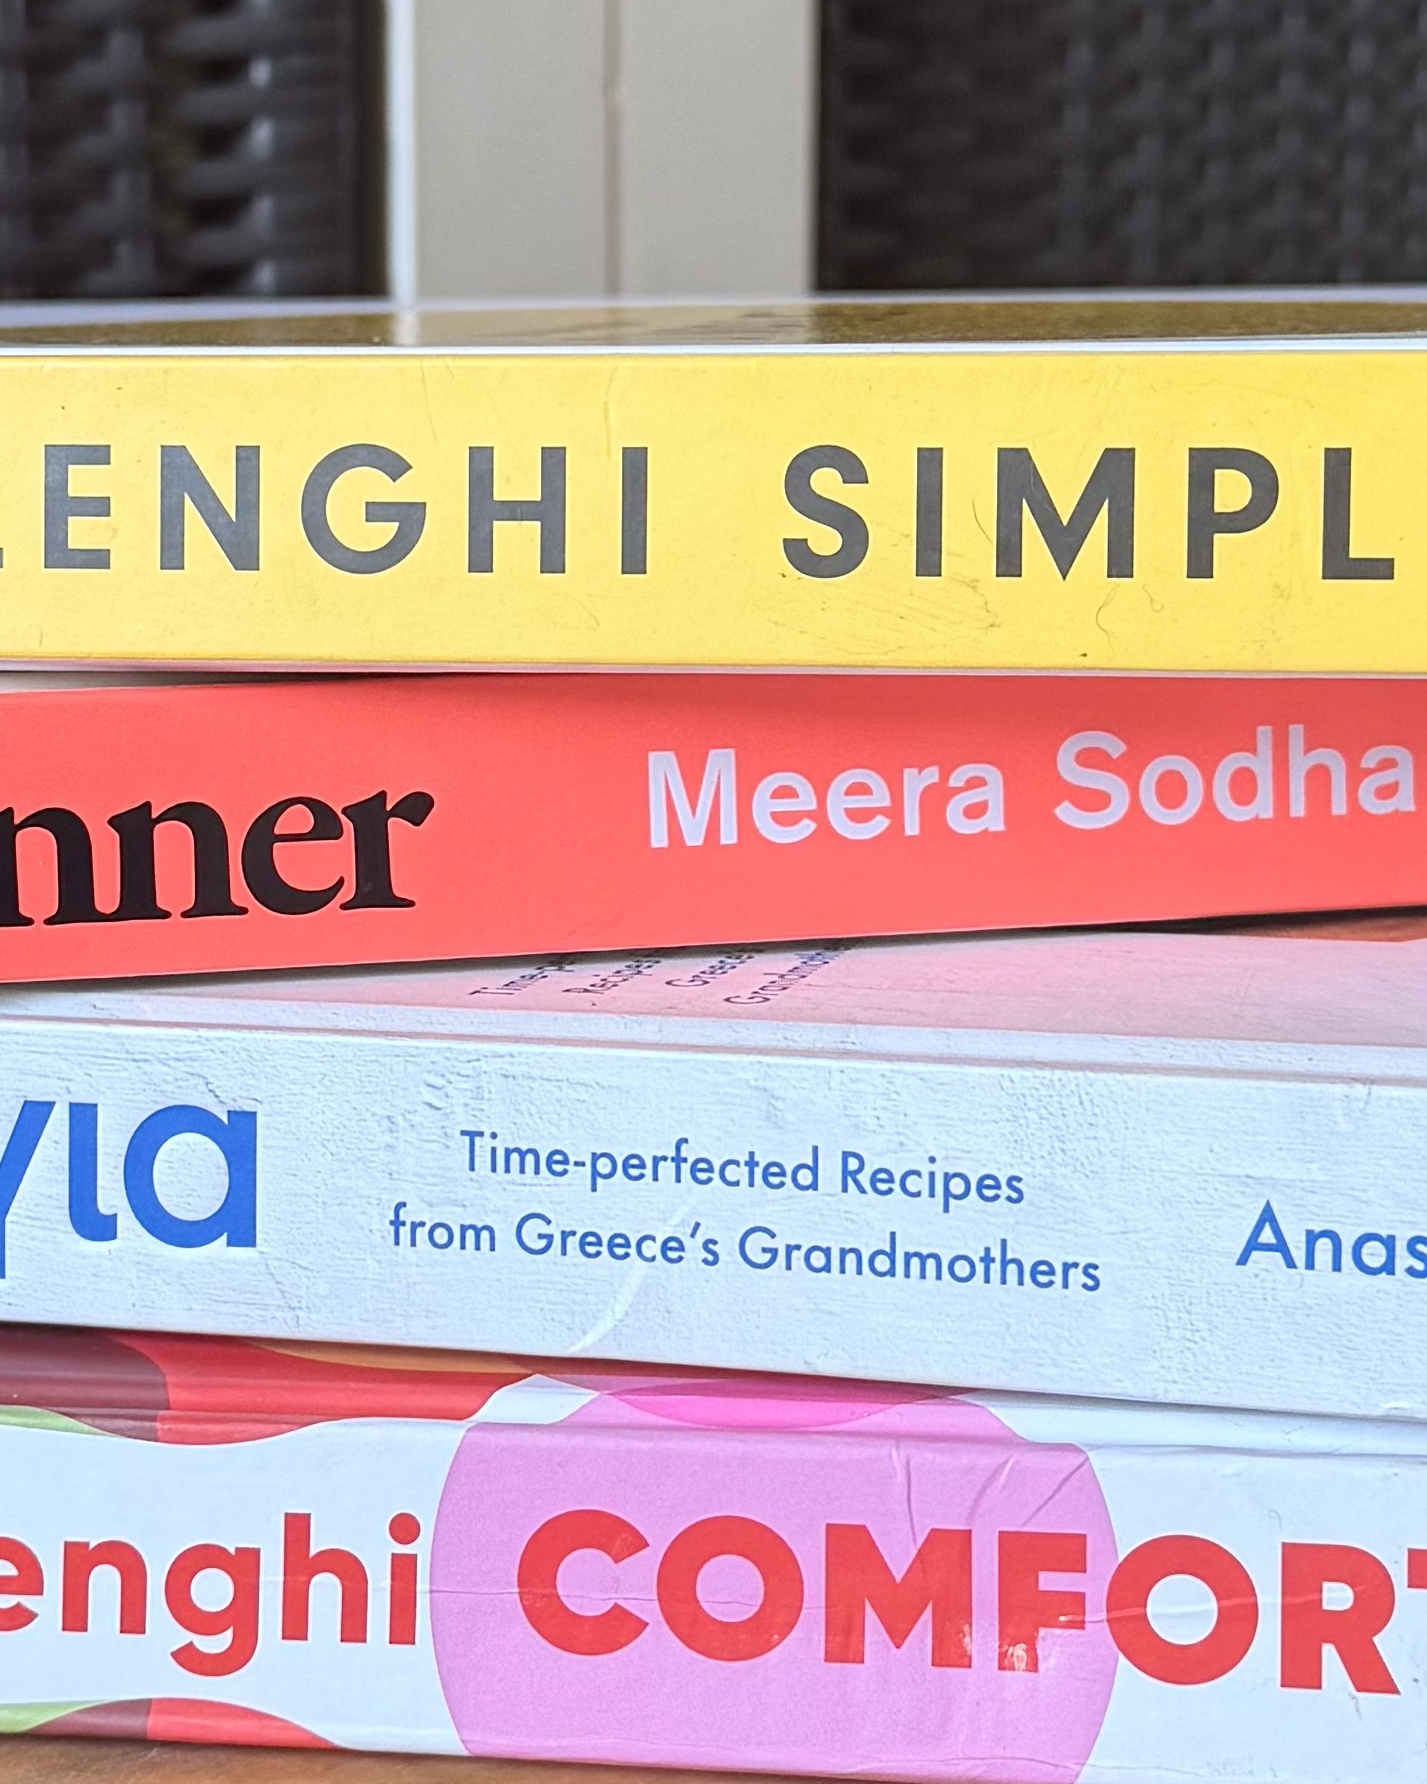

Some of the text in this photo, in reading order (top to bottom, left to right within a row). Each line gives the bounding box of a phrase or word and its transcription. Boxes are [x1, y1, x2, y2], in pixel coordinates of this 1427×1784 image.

[646, 723, 1418, 850] Meera Sodha
[458, 1128, 1026, 1208] Time-perfected Recipes
[387, 1200, 497, 1254] from
[737, 1224, 1102, 1293] Grandmothers
